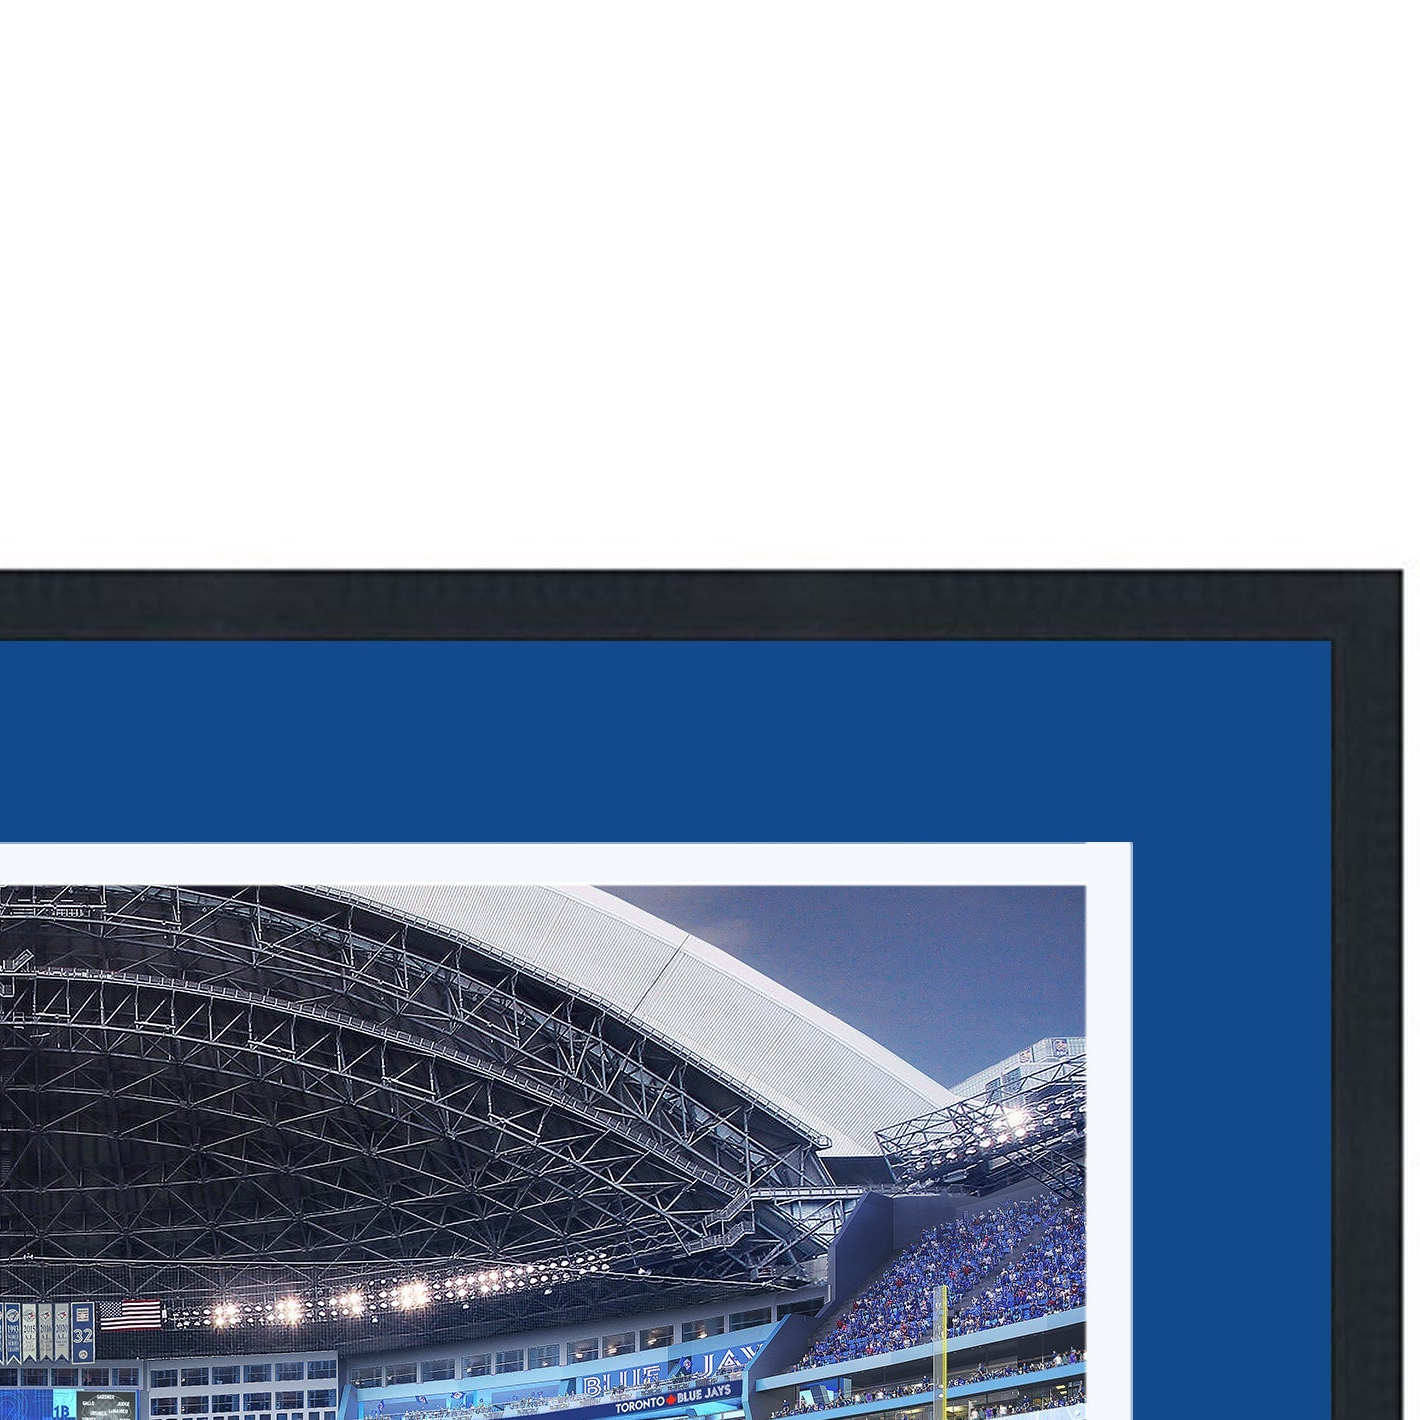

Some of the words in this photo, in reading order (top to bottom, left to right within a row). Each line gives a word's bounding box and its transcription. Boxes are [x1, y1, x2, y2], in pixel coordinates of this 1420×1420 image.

[74, 1328, 92, 1343] 32
[616, 1396, 665, 1413] TORONTO
[677, 1389, 702, 1403] BLUE
[705, 1384, 731, 1400] JAYS
[54, 1405, 69, 1417] 1B
